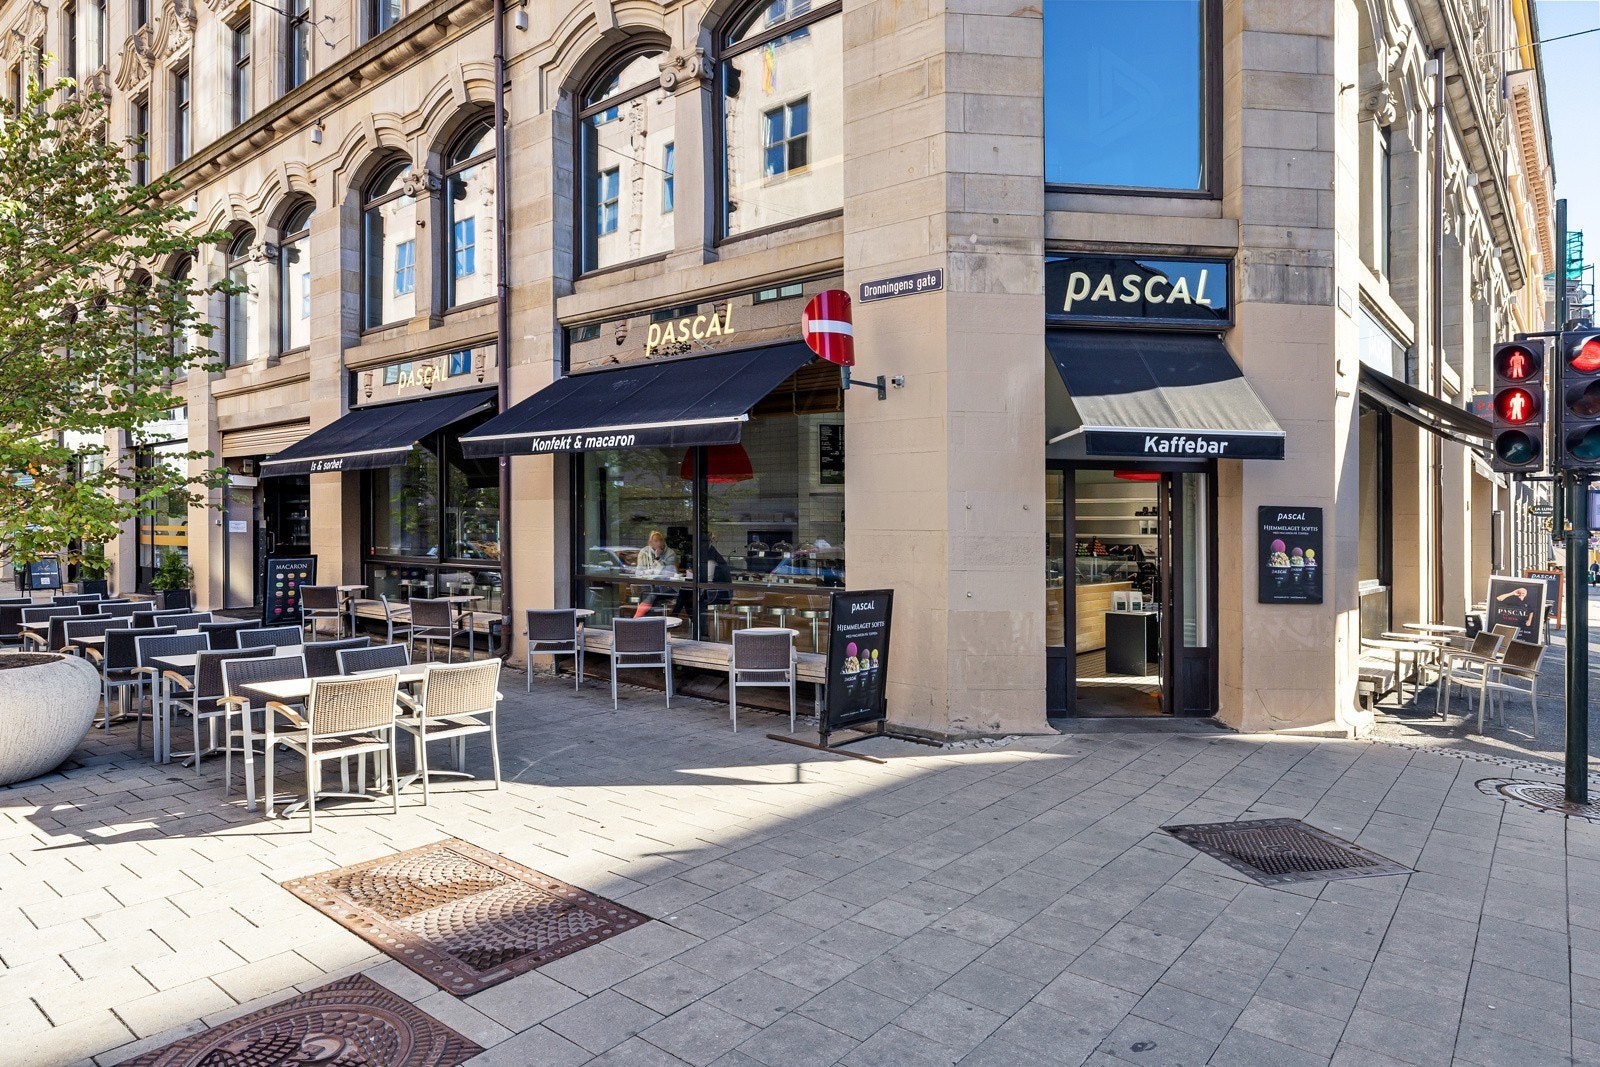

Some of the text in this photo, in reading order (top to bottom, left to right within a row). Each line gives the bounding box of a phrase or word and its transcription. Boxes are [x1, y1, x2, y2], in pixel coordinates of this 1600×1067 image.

[864, 274, 937, 297] Dronningens gate
[532, 433, 635, 452] Konfekt & macaron
[1144, 435, 1229, 454] Kaffebar
[316, 460, 323, 470] &
[323, 458, 343, 470] sorbet
